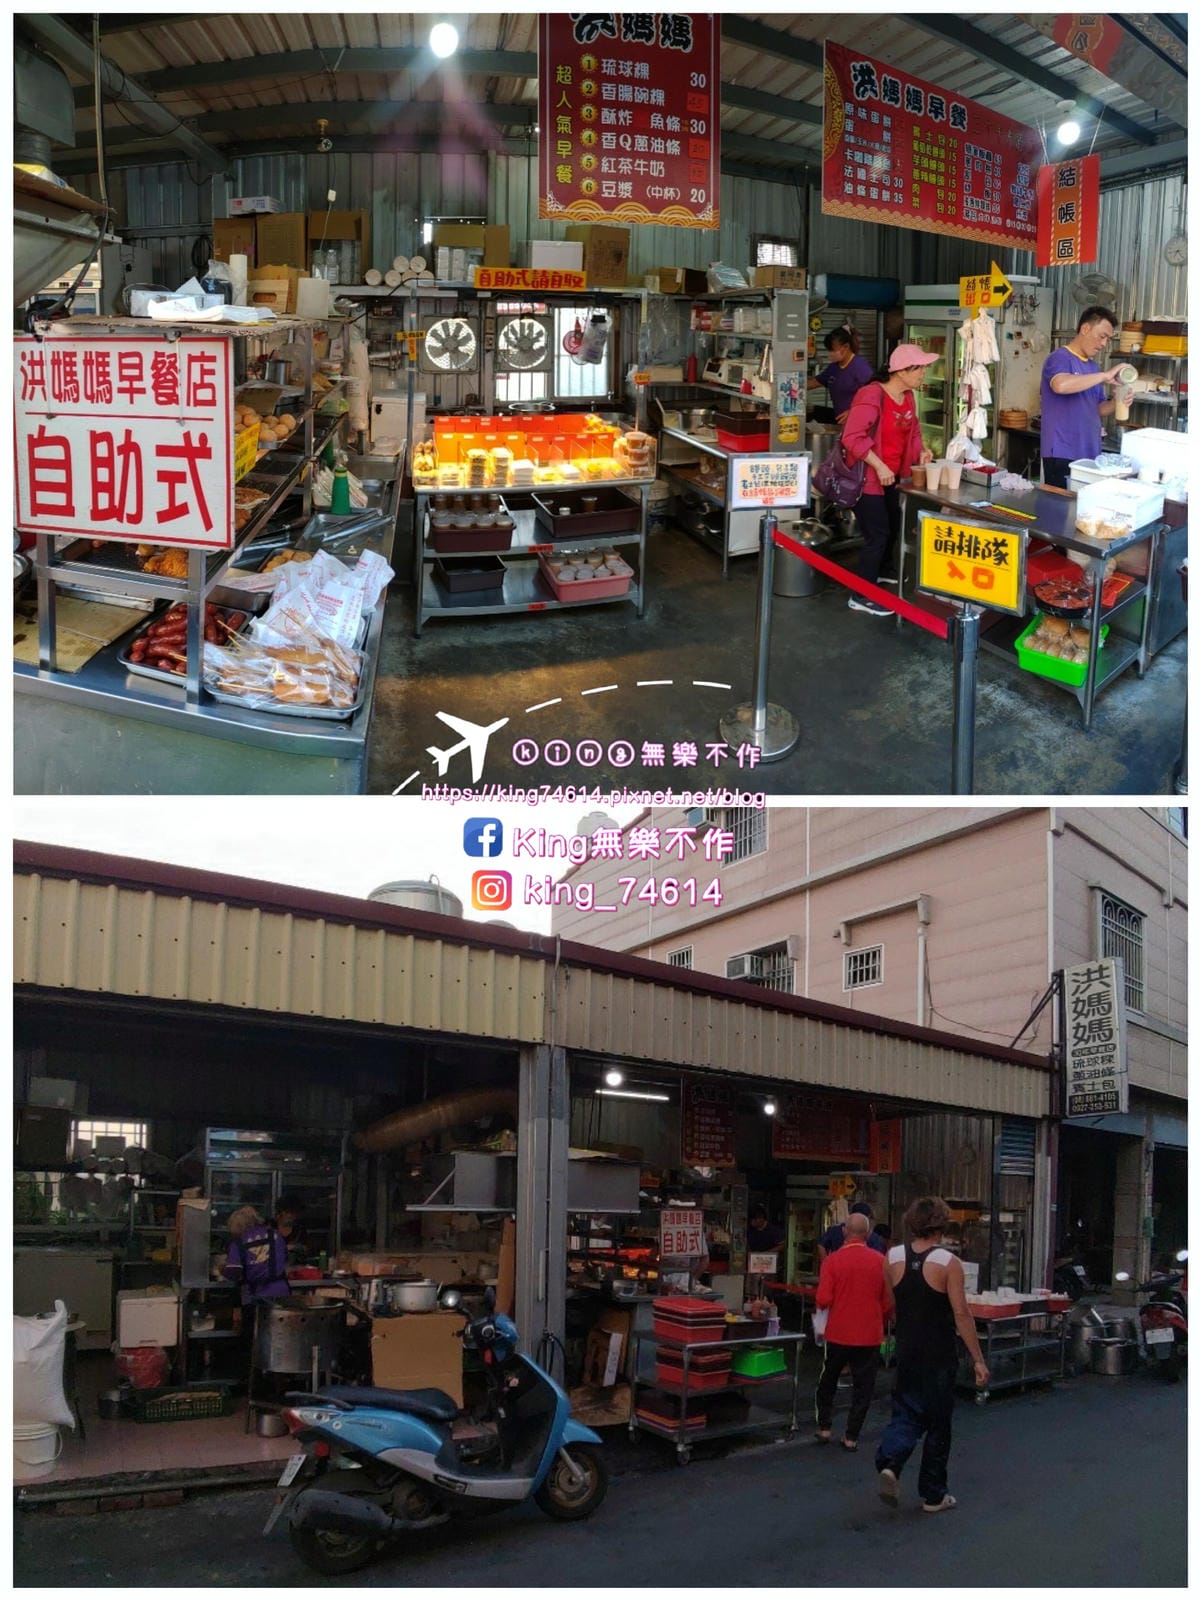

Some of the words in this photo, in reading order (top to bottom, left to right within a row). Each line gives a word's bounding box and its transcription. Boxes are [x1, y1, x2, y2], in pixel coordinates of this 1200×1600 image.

[601, 59, 650, 80] 琉球粿
[690, 72, 706, 88] 30
[601, 83, 665, 106] 香腸碗粿
[850, 61, 968, 132] 洪媽媽早餐
[555, 64, 573, 184] 超人氣早餐
[601, 108, 633, 126] 酥炸
[650, 112, 681, 133] 魚條
[690, 119, 706, 135] 30
[601, 132, 681, 156] 香Q蔥油條
[601, 156, 665, 178] 紅茶牛奶
[601, 181, 633, 199] 豆漿
[690, 188, 706, 204] 20
[894, 176, 903, 189] 30
[894, 192, 903, 204] 35
[1057, 166, 1077, 259] 結帳區
[479, 269, 585, 289] 自助式請自取
[966, 276, 991, 291] 結帳
[20, 350, 217, 407] 洪媽媽早餐店
[27, 424, 214, 533] 自助式
[933, 525, 1009, 566] 請排隊
[947, 560, 995, 590] 入口
[1071, 964, 1114, 1047] 洪媽媽
[663, 1231, 701, 1254] 自助式
